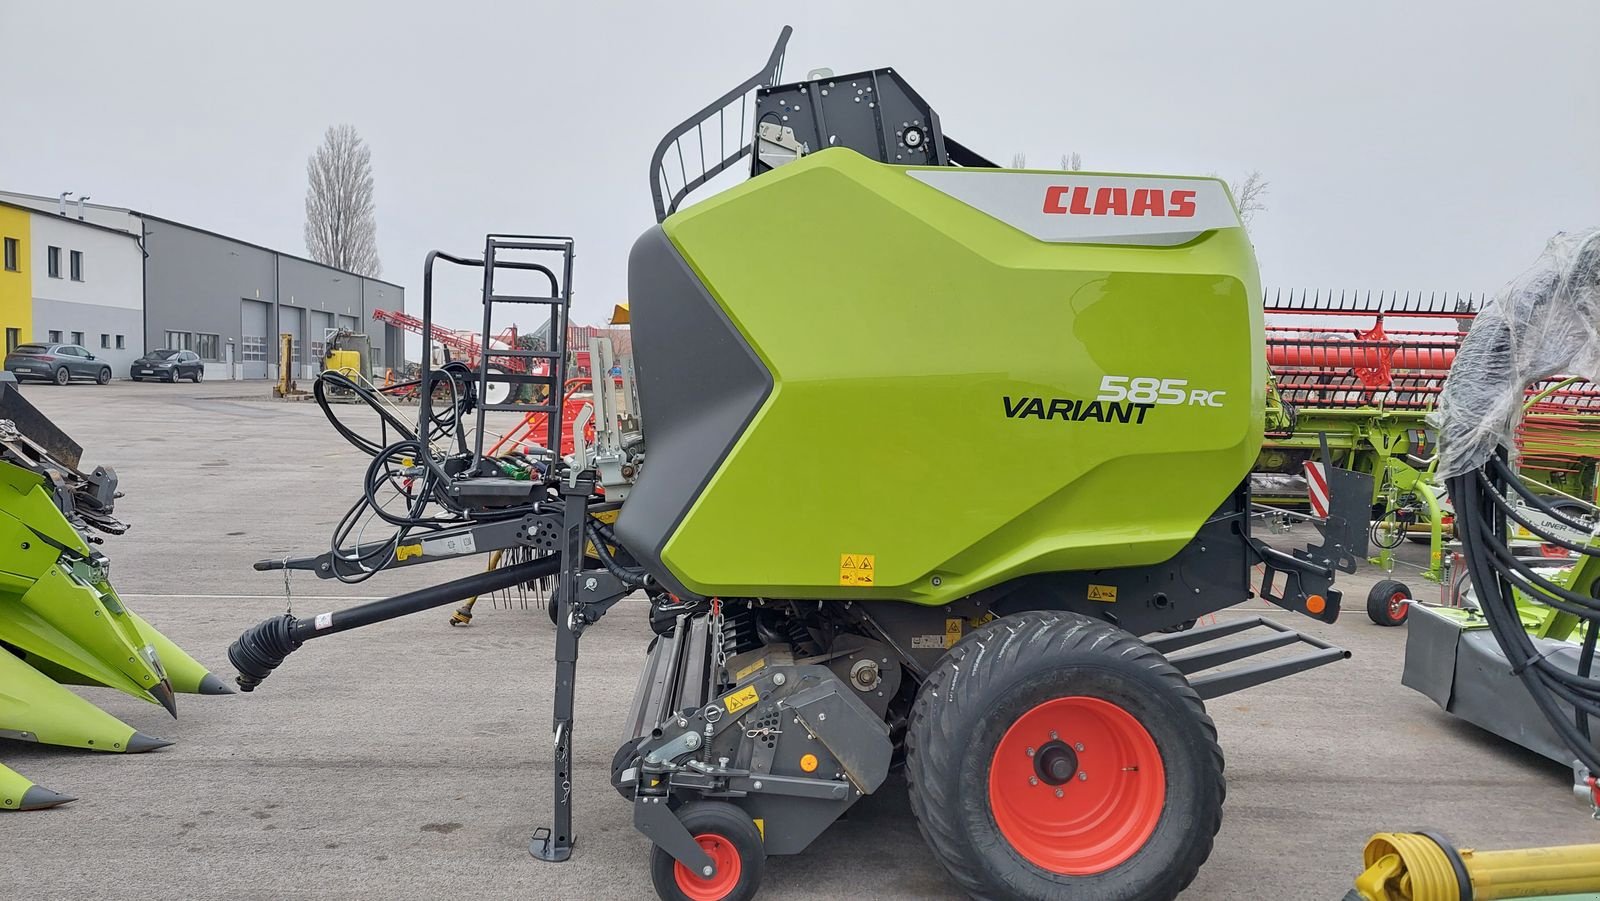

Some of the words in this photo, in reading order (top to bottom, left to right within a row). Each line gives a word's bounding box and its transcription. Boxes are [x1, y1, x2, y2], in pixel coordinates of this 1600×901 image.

[1042, 185, 1196, 218] CLAAS
[1096, 375, 1188, 405] 585
[1188, 389, 1226, 407] RC
[1002, 396, 1155, 424] VARIANT
